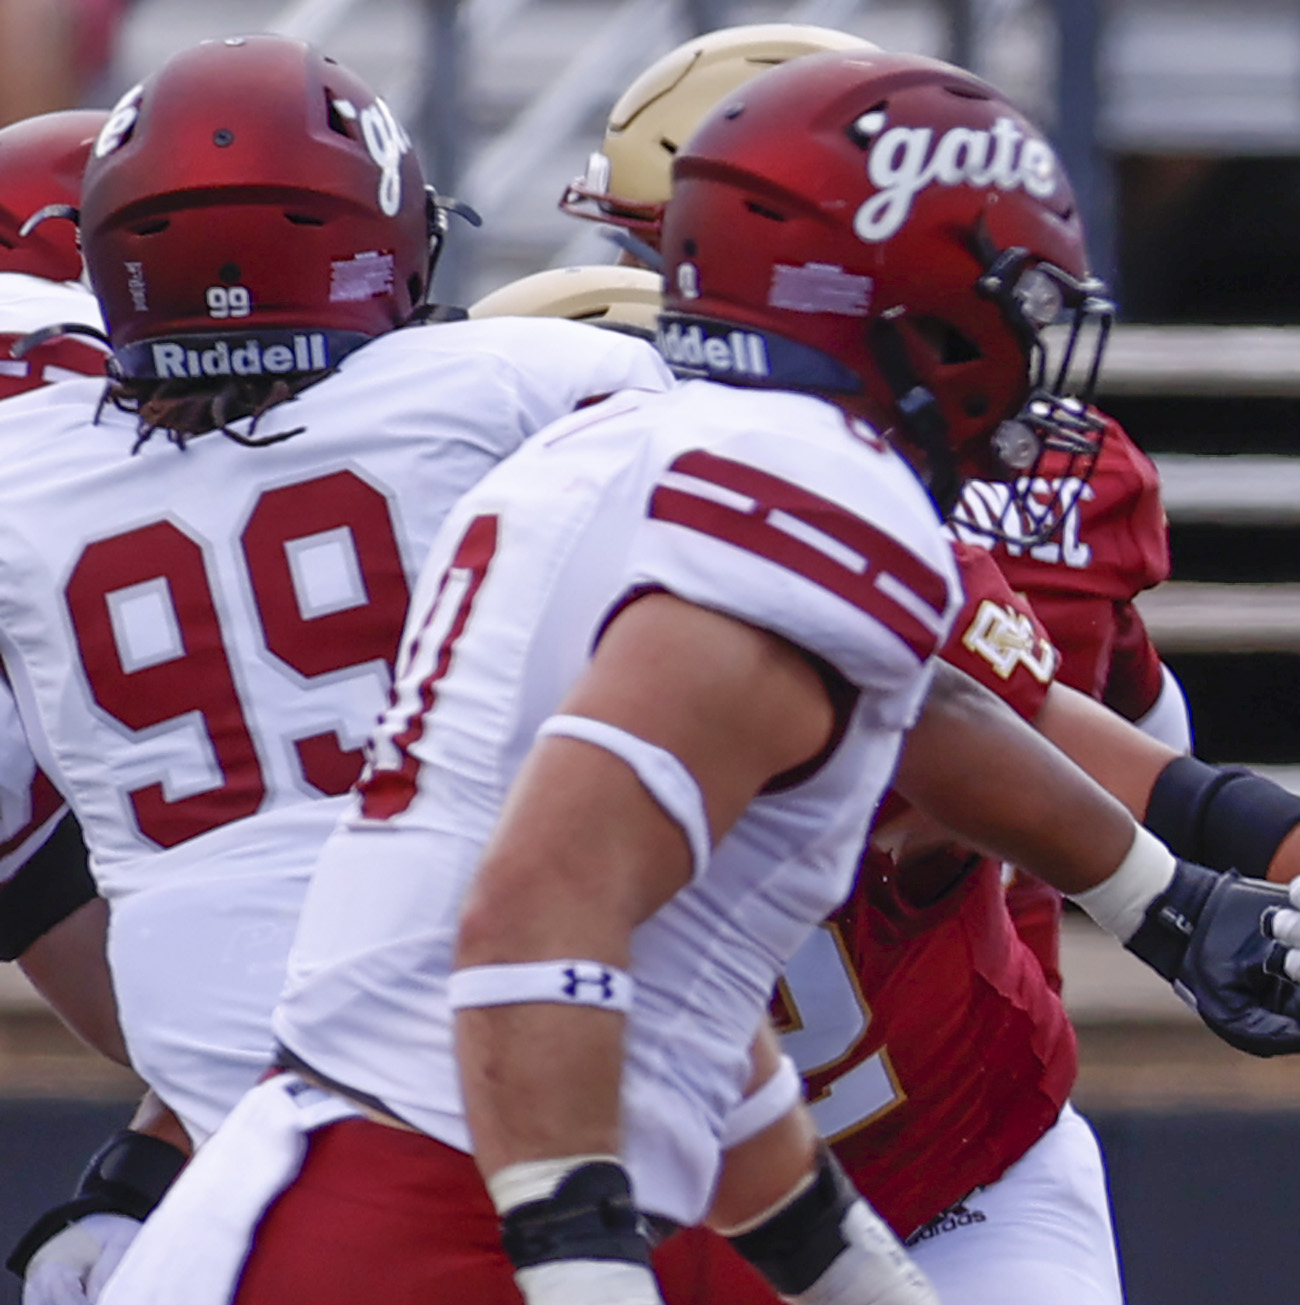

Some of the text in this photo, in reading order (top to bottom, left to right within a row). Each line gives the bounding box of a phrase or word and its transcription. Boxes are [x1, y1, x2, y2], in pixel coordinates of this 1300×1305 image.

[206, 286, 250, 318] 99
[152, 332, 326, 378] Riddell
[57, 461, 414, 851] 99
